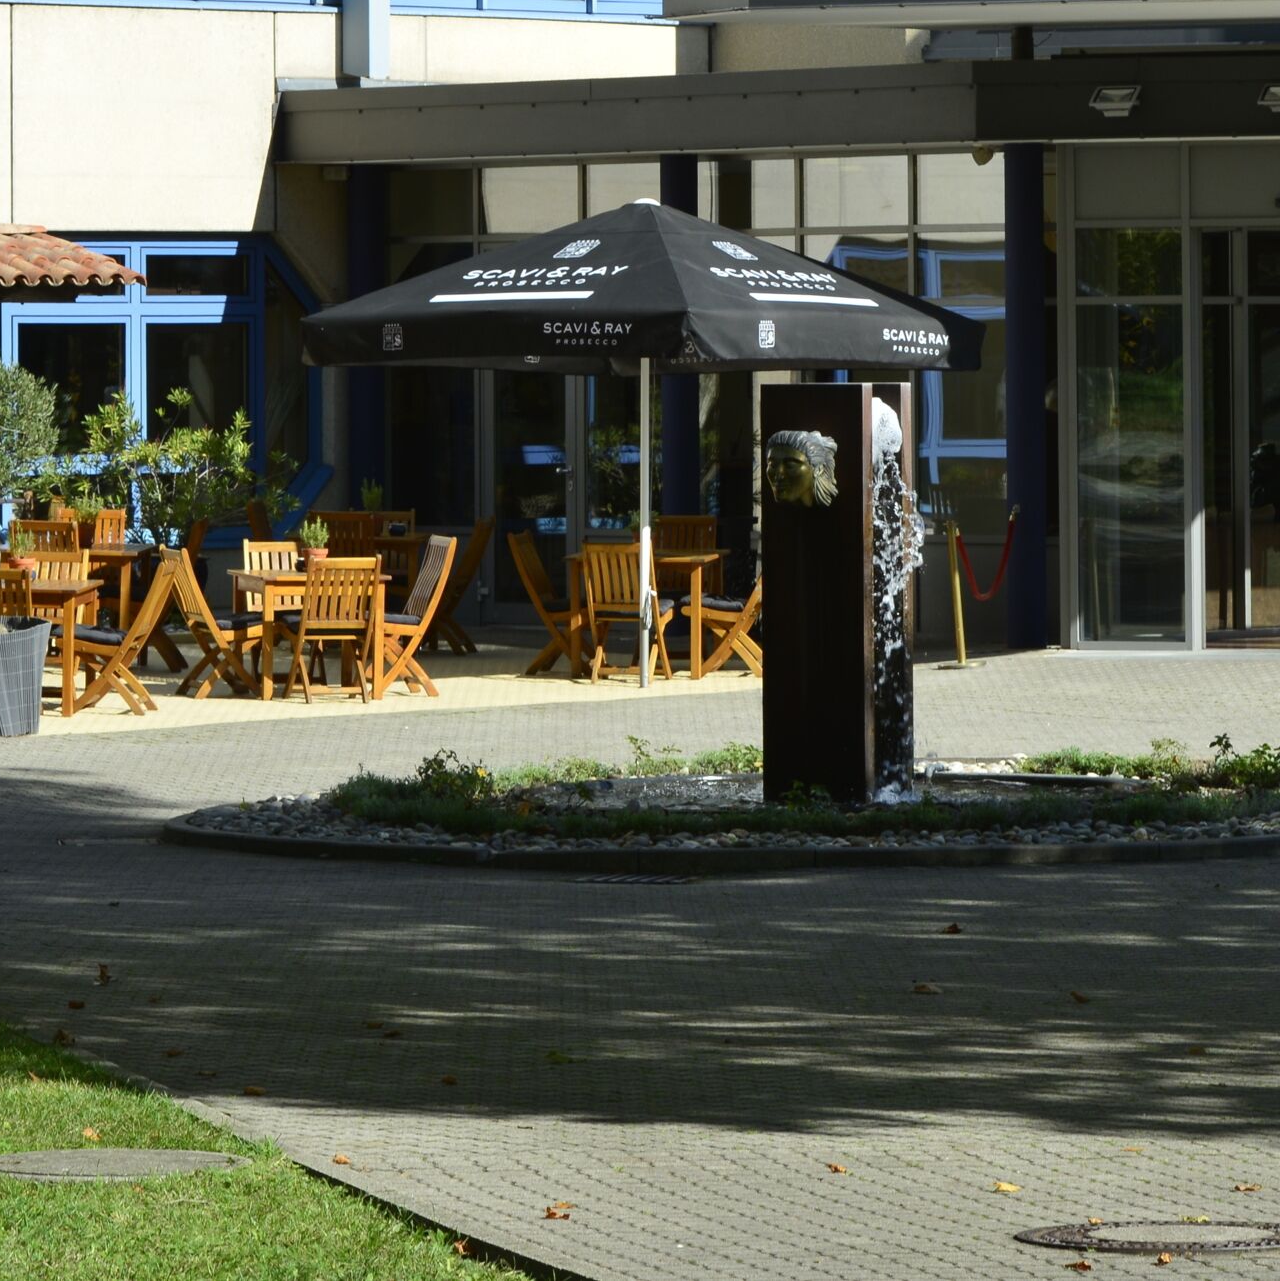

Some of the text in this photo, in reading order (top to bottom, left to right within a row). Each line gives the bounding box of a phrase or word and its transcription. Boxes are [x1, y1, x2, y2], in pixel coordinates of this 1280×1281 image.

[473, 278, 586, 287] PROSECCO
[555, 338, 618, 346] PROSECCO
[893, 344, 940, 357] PROSECCO
